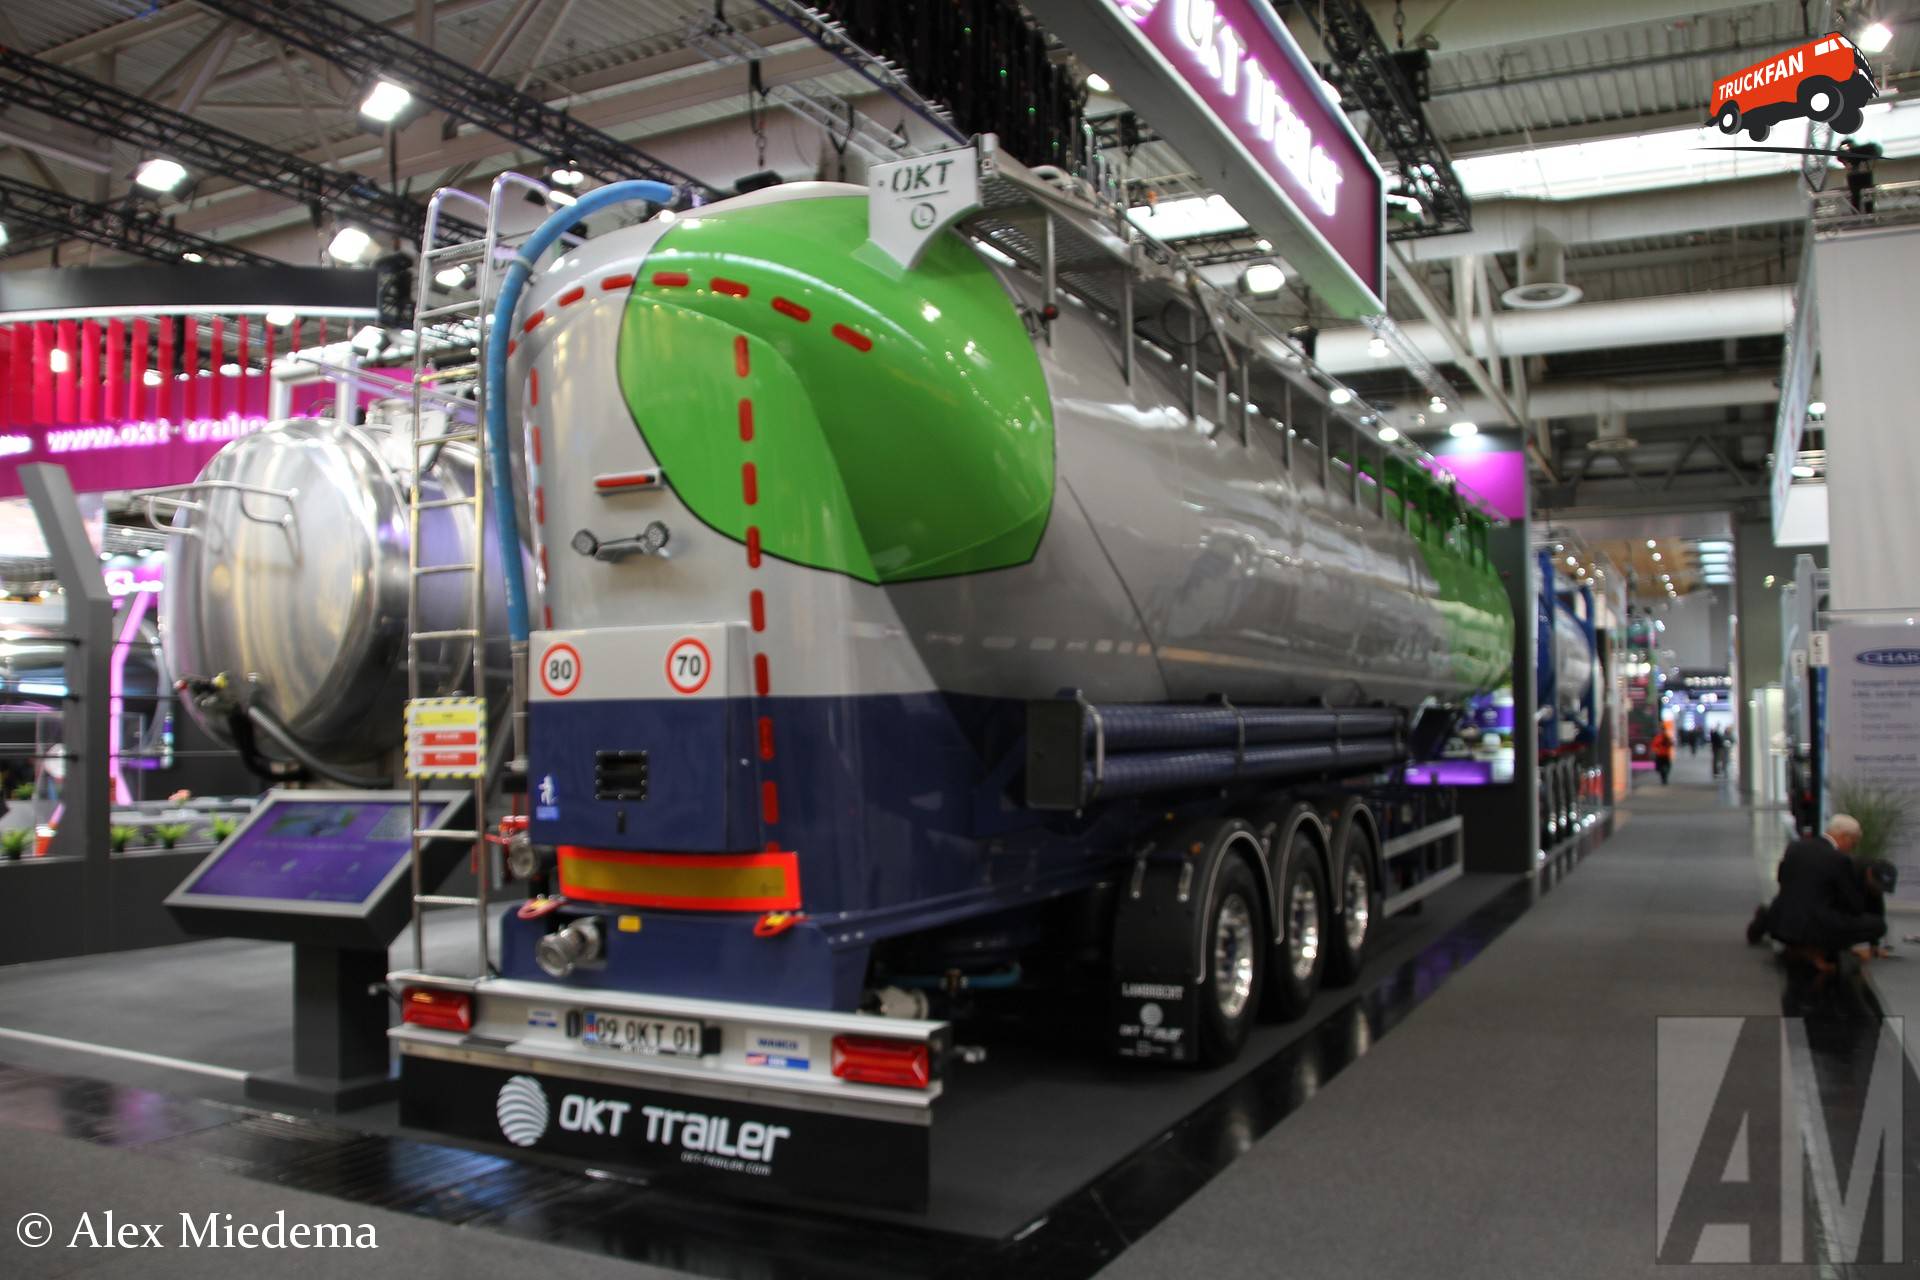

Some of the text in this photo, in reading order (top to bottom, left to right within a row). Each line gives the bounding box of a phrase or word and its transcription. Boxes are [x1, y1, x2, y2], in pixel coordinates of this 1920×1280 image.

[892, 159, 954, 192] OKT
[550, 659, 573, 680] 80
[676, 655, 702, 677] 70
[596, 1018, 695, 1049] 09 OKT 01
[559, 1094, 632, 1137] OKT
